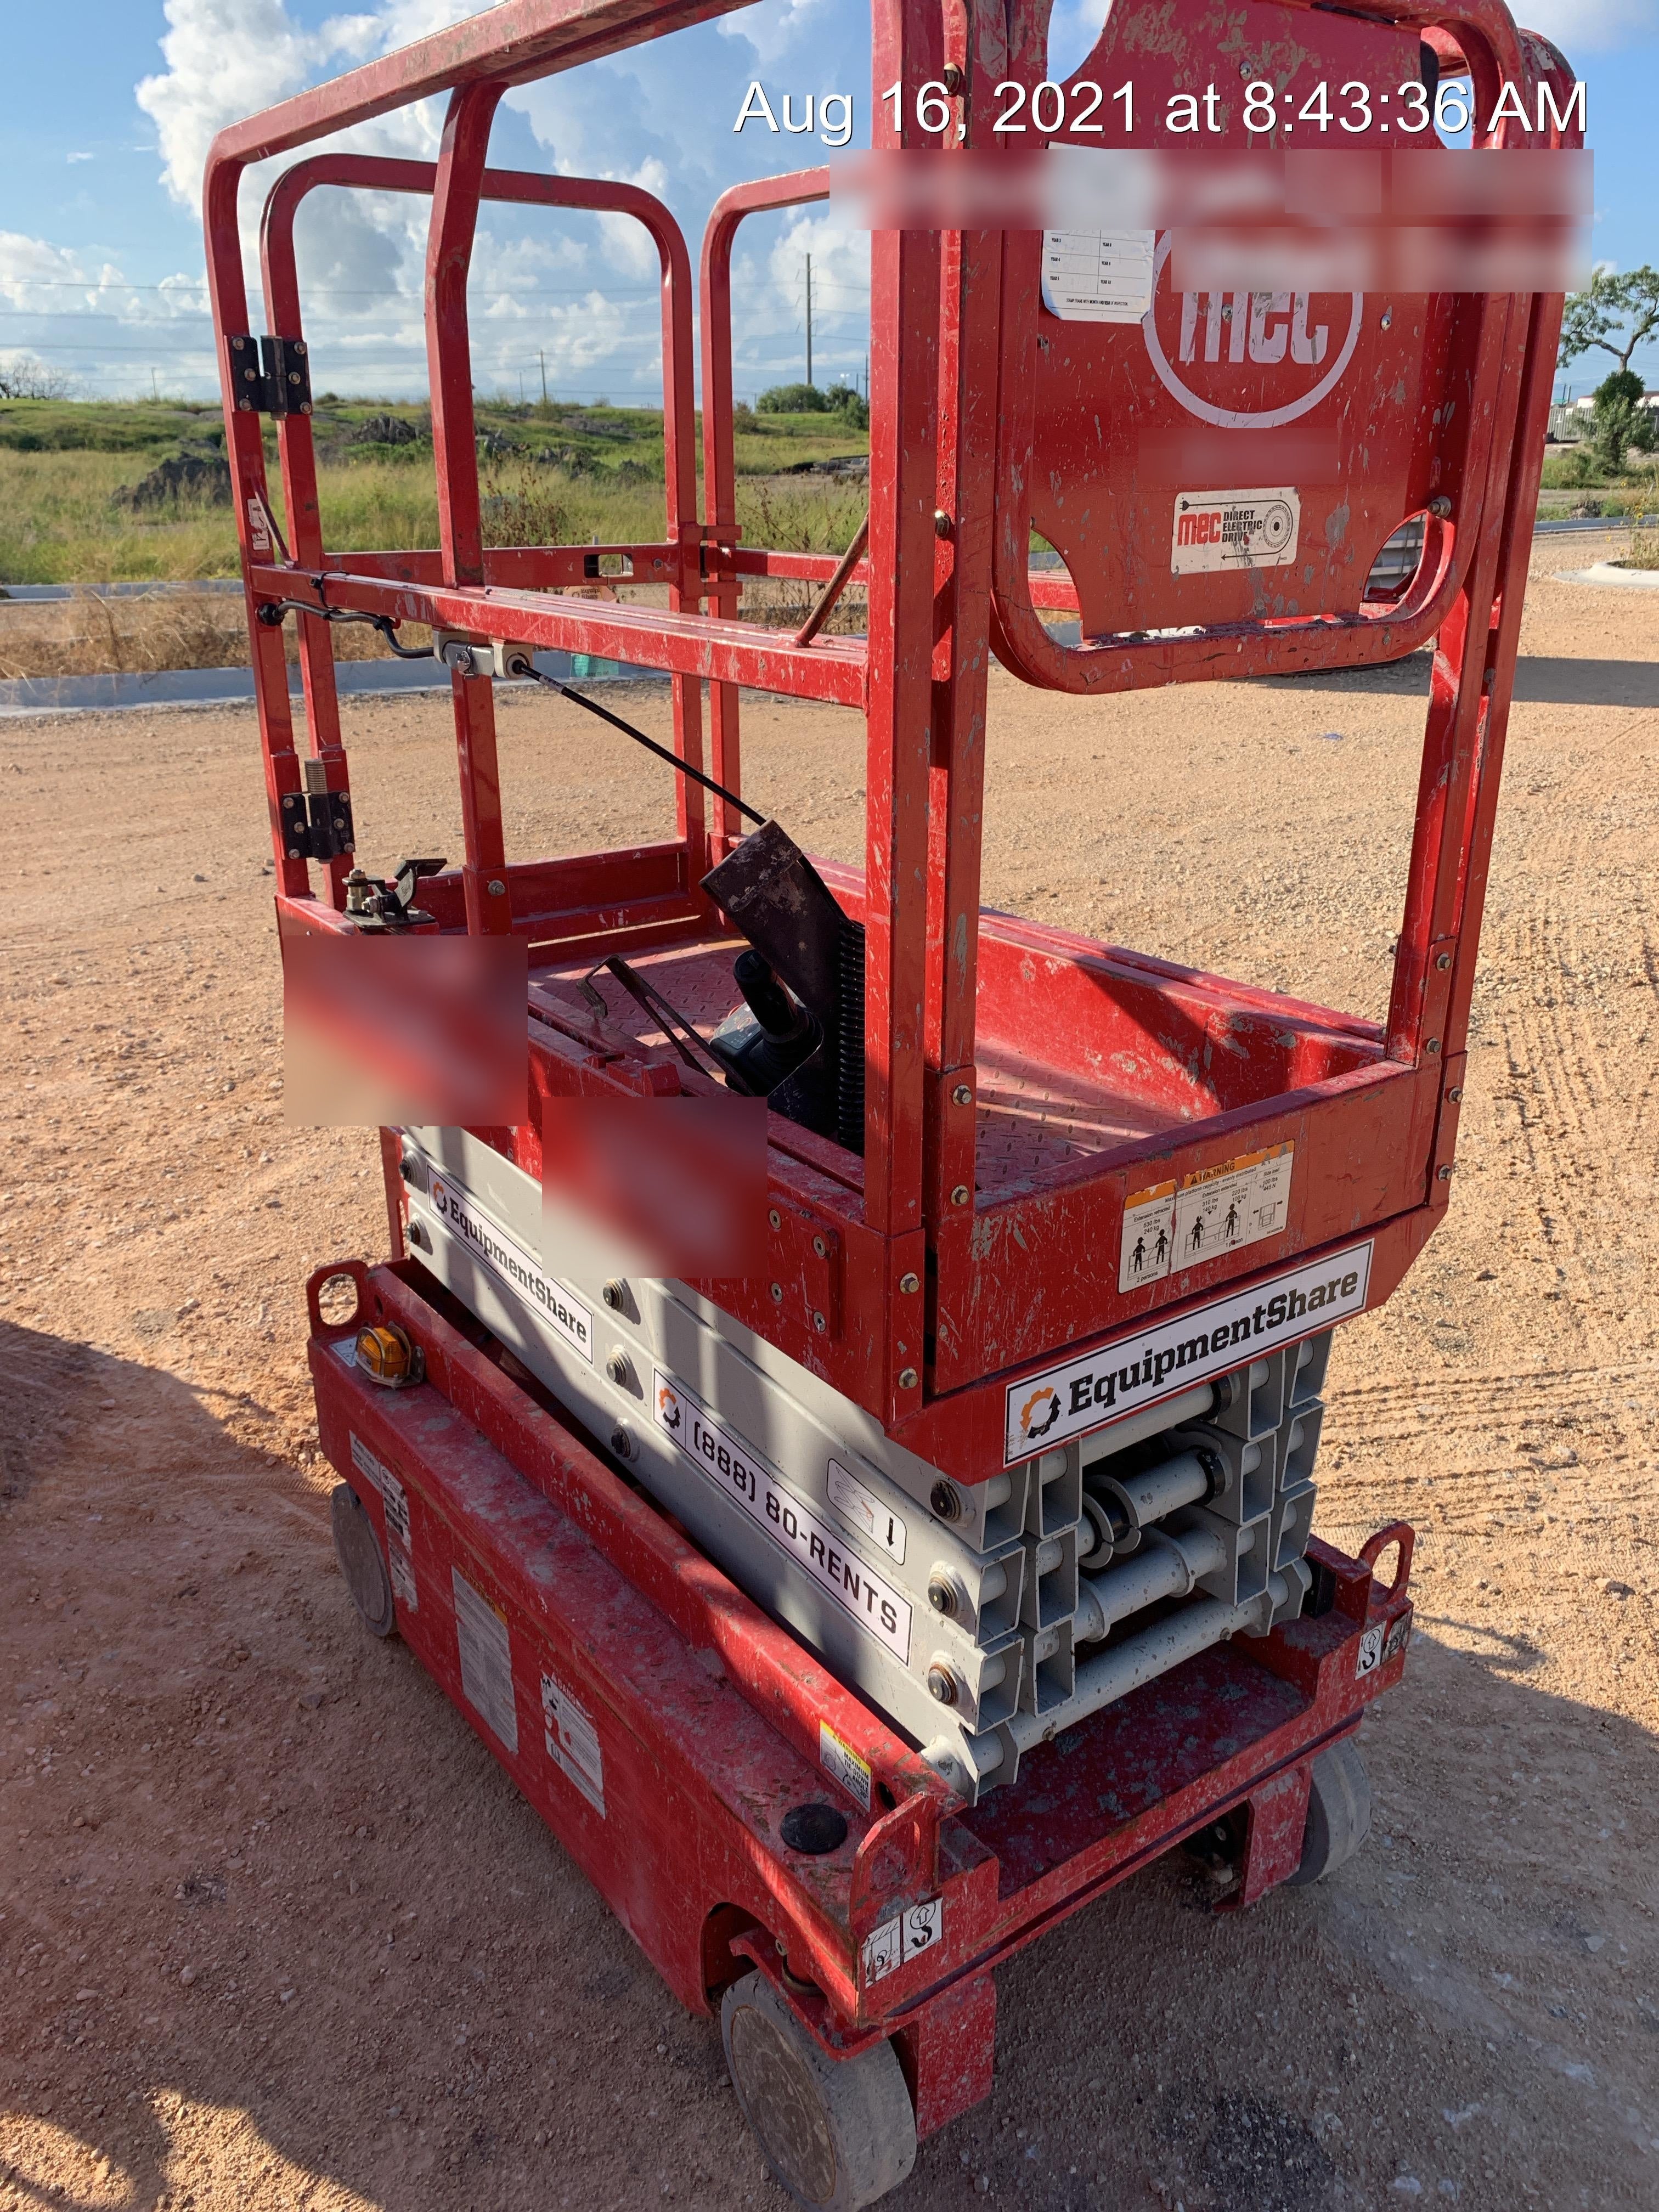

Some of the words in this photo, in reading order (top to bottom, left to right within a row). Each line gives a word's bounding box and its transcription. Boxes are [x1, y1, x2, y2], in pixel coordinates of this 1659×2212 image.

[1223, 510, 1255, 521] DIRECT
[1222, 520, 1263, 532] ELECTRIC
[1185, 1185, 1202, 1197] platform
[1202, 1180, 1220, 1190] capacity
[1222, 1175, 1235, 1183] evenly
[1235, 1167, 1257, 1178] distributed
[1199, 1163, 1235, 1182] WARNING
[1202, 1188, 1221, 1198] Extension
[1221, 1182, 1238, 1192] extended
[1134, 1212, 1153, 1222] Extension
[1153, 1205, 1171, 1215] retracted
[1229, 1238, 1243, 1248] pson
[449, 1194, 587, 1344] EquipmentShare
[1141, 1271, 1158, 1282] persons
[1068, 1271, 1358, 1416] EquipmentShare
[693, 1420, 756, 1503] (888)
[766, 1491, 898, 1635] 80-RENTS
[838, 1740, 861, 1764] WARNING
[844, 1751, 869, 1781] MAXIMUM
[853, 1775, 868, 1795] ANGLE
